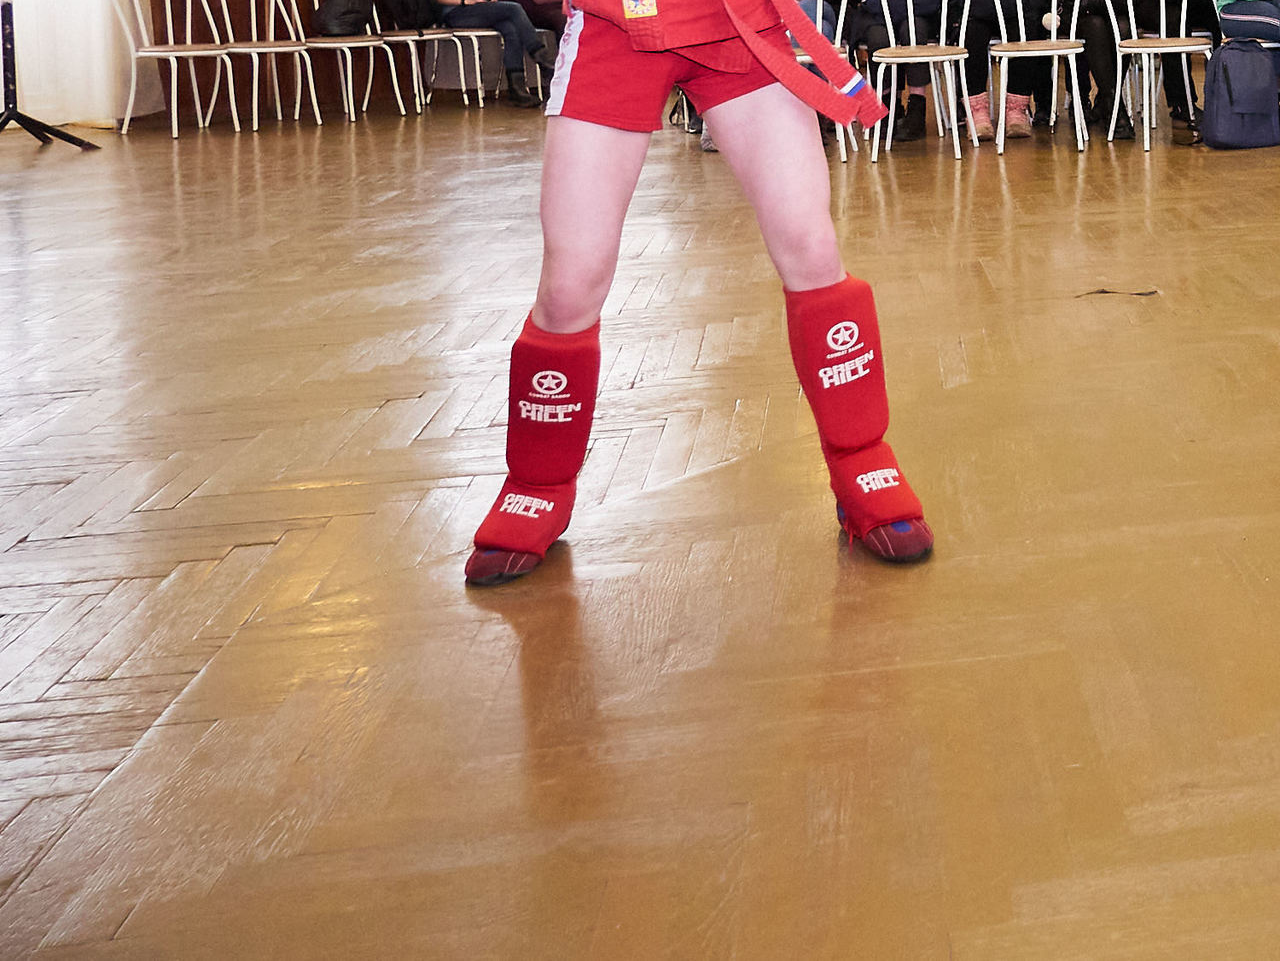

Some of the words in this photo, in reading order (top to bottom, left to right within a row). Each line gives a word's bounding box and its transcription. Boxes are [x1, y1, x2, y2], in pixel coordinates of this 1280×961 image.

[818, 349, 875, 379] GREEN
[822, 365, 871, 389] HILL
[518, 400, 582, 413] GREEN
[520, 407, 572, 422] HILL
[856, 467, 899, 484] GREEN
[860, 476, 900, 493] HILL
[499, 501, 540, 518] HILL
[504, 493, 555, 512] GREEN
